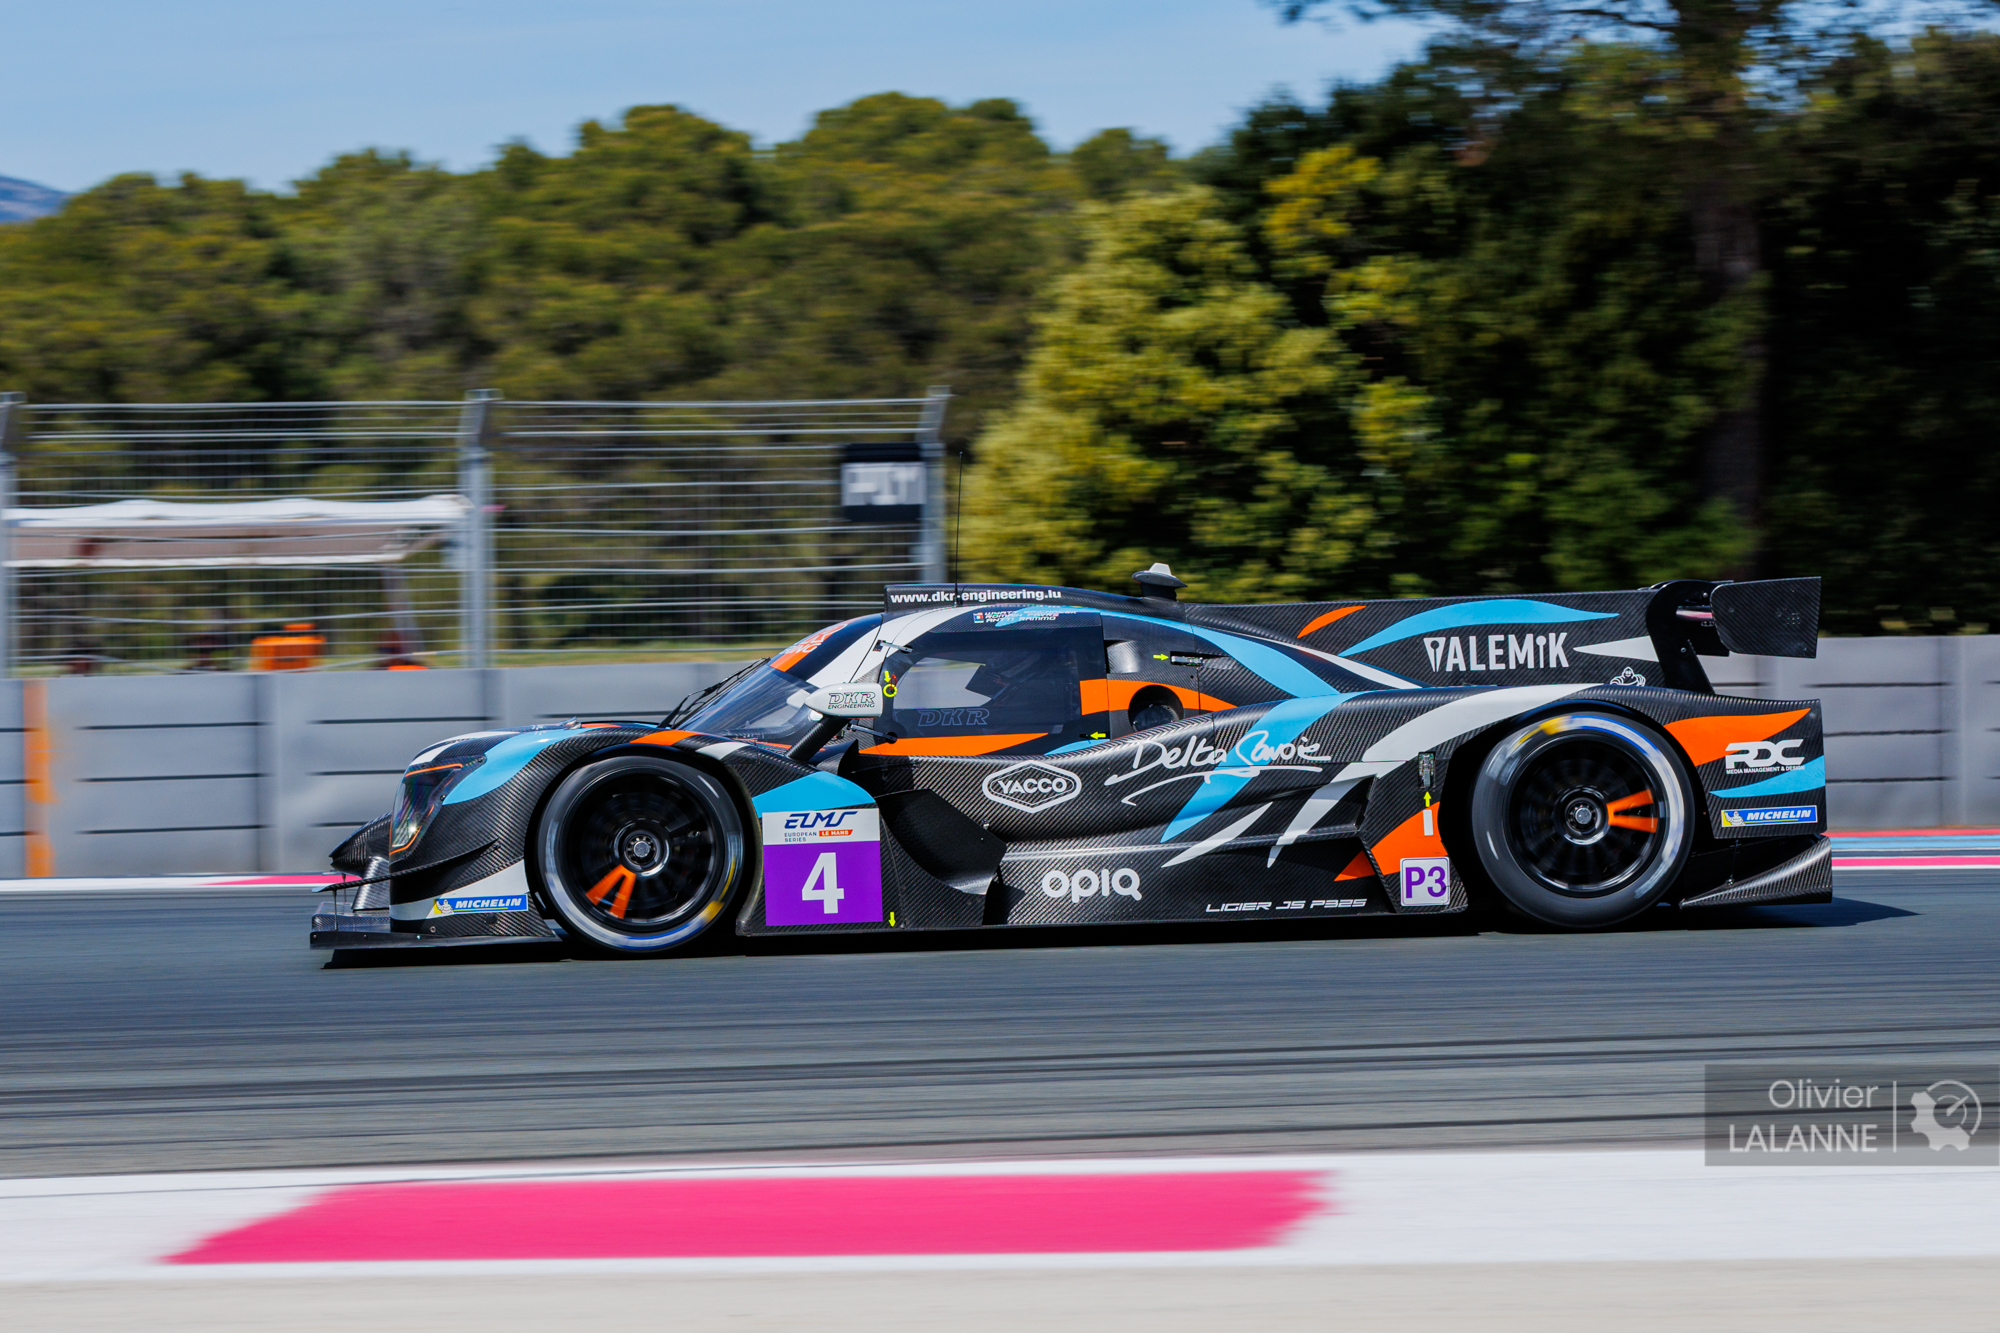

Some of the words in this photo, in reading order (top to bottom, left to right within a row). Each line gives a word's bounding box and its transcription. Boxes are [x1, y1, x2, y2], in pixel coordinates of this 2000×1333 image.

[890, 589, 1062, 603] www.dkr-engineering.lu
[828, 691, 876, 705] DKR
[917, 707, 990, 727] DKR
[1104, 735, 1227, 786] Delta
[1725, 738, 1805, 769] RDC
[1743, 766, 1780, 774] MANAGEMENT
[998, 778, 1067, 793] YACCO
[784, 811, 858, 829] ELMS
[1746, 810, 1811, 821] MICHELIN
[801, 852, 844, 914] 4
[1405, 866, 1446, 898] P3
[455, 898, 522, 909] MICHELIN
[1205, 901, 1272, 912] LIGIER
[1275, 900, 1306, 910] JS
